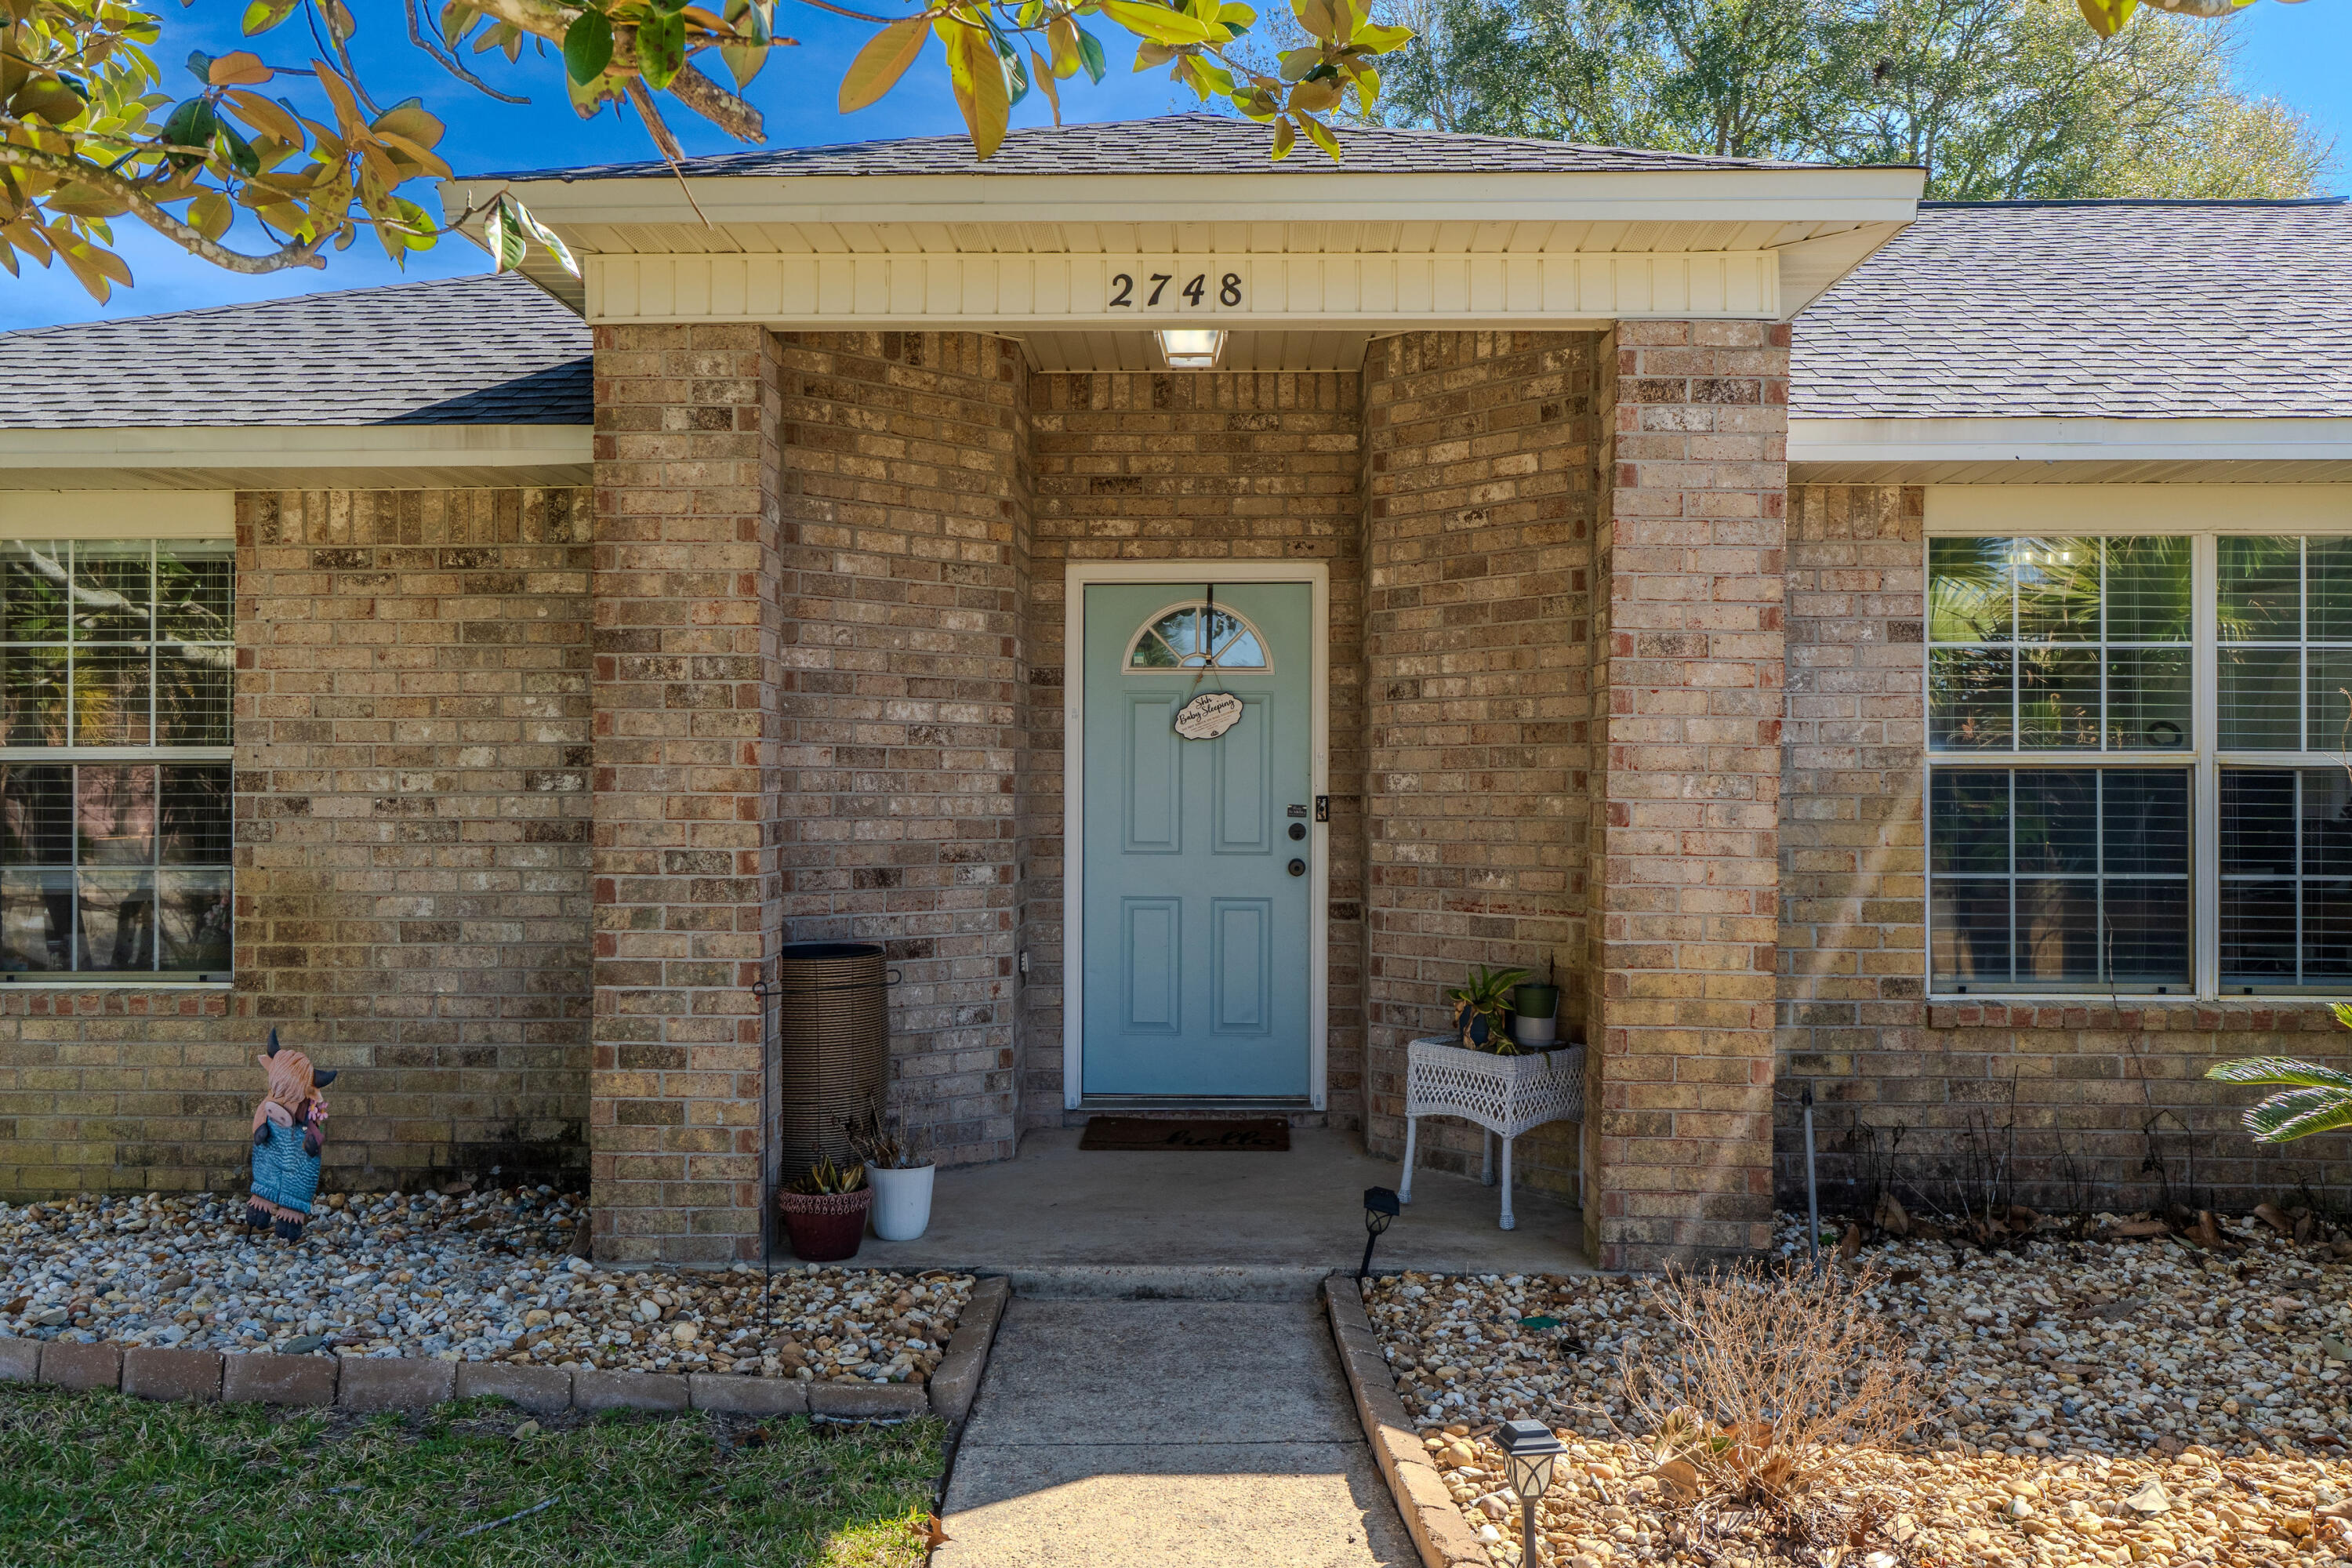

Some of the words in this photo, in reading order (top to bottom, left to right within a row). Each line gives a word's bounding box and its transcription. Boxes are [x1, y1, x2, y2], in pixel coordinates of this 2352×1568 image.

[1109, 273, 1241, 307] 2748
[1179, 710, 1202, 724] Baby
[1202, 699, 1235, 717] Sleeping
[1196, 695, 1213, 709] Shh
